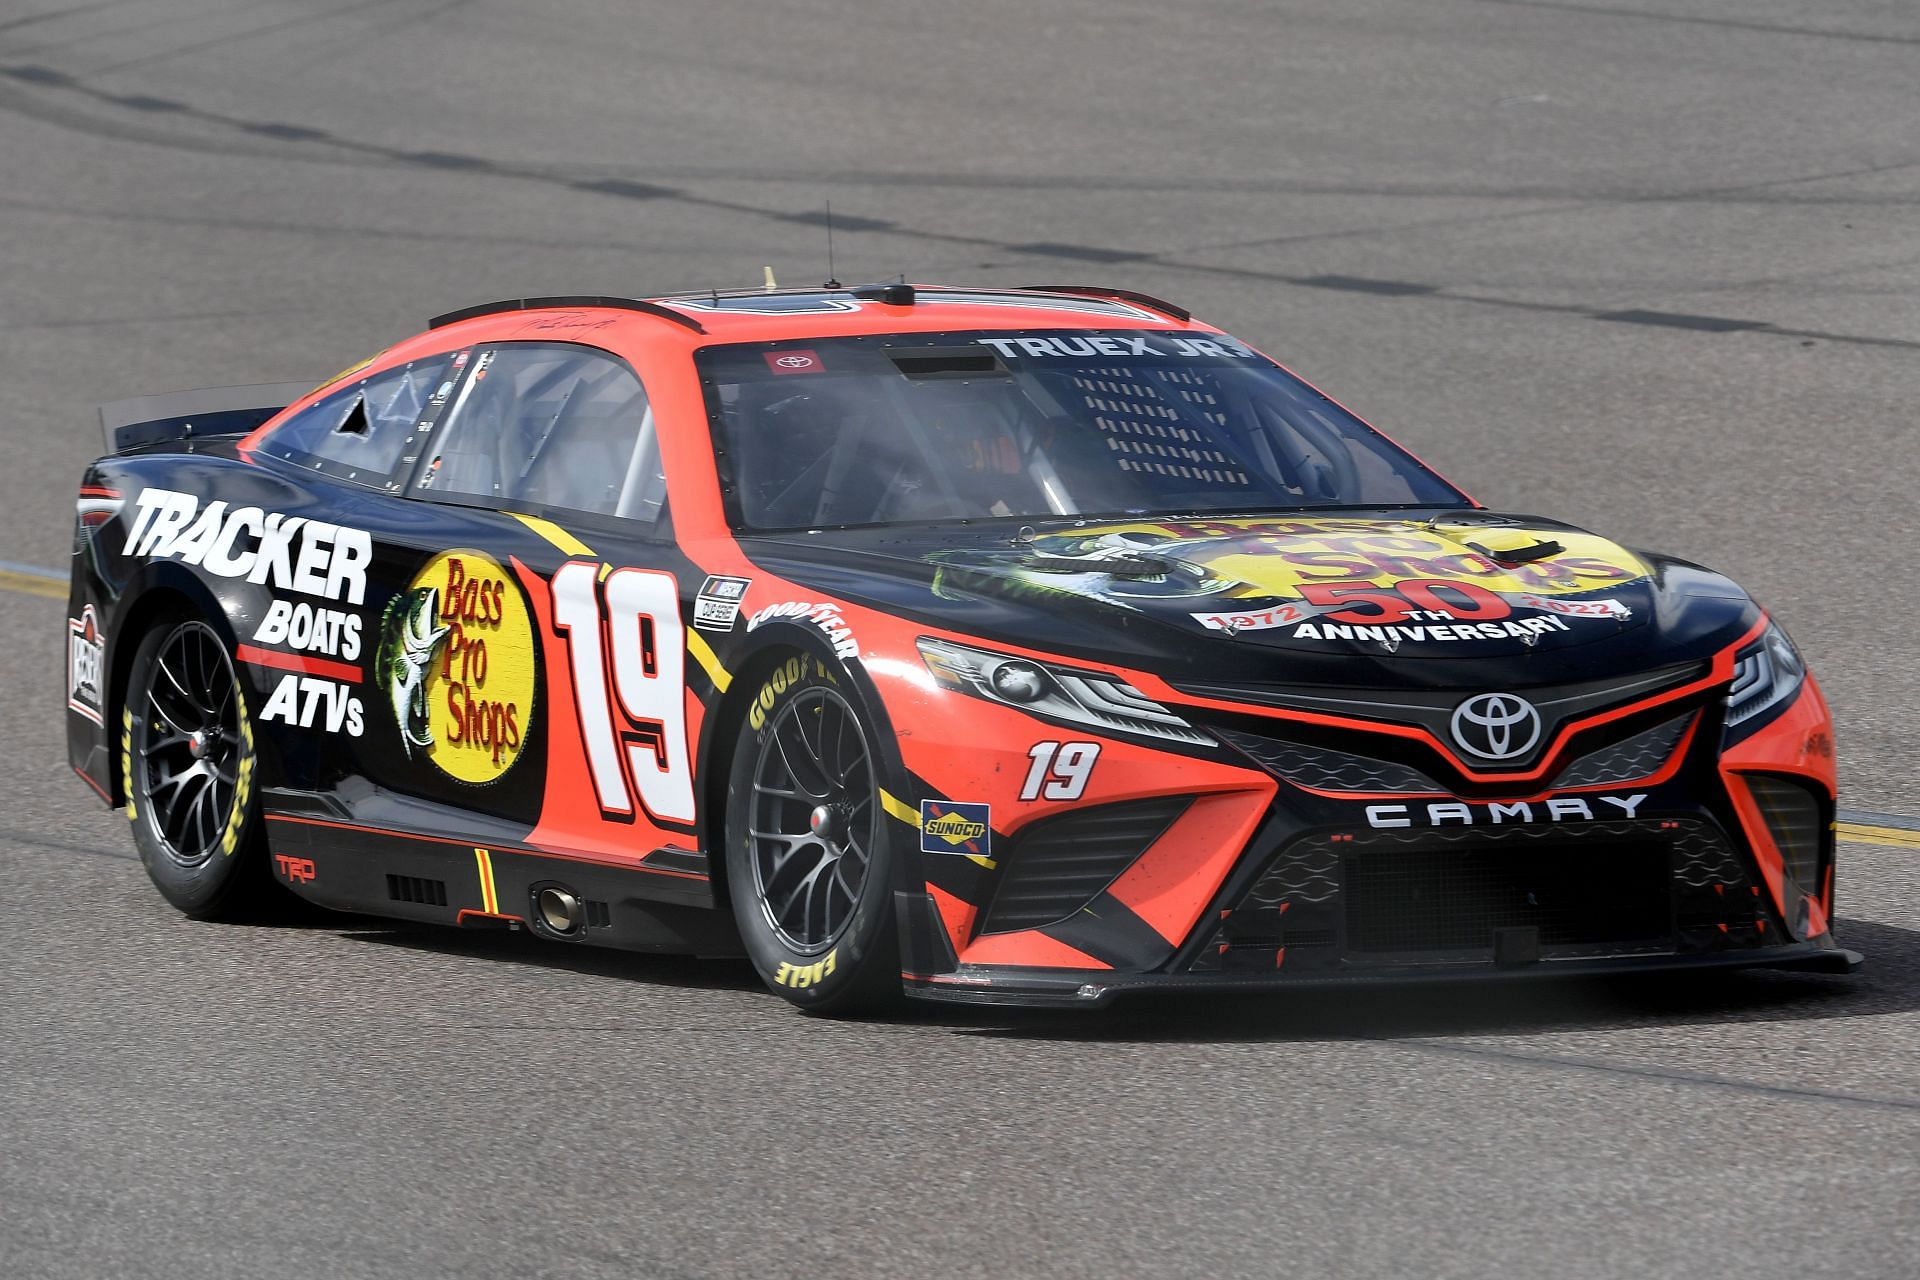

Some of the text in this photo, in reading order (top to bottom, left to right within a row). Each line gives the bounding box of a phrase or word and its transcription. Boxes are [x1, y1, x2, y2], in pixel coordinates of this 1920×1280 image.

[976, 336, 1168, 357] TRUEX
[121, 487, 372, 605] TRACKER
[441, 557, 505, 625] Bass
[1292, 578, 1513, 625] 50
[1401, 610, 1456, 622] TH
[1520, 595, 1617, 614] 2022
[253, 599, 363, 661] BOATS
[441, 621, 488, 684] Pro
[746, 601, 860, 661] GOODYEAR
[1292, 614, 1571, 642] ANNIVERSARY
[259, 674, 365, 737] ATVs
[446, 681, 520, 764] Shops
[550, 561, 697, 834] 19
[1018, 740, 1103, 802] 19
[927, 820, 983, 837] SUNOCO
[1364, 794, 1649, 829] CAMRY
[274, 853, 316, 884] TRD
[774, 946, 839, 989] EAGLE
